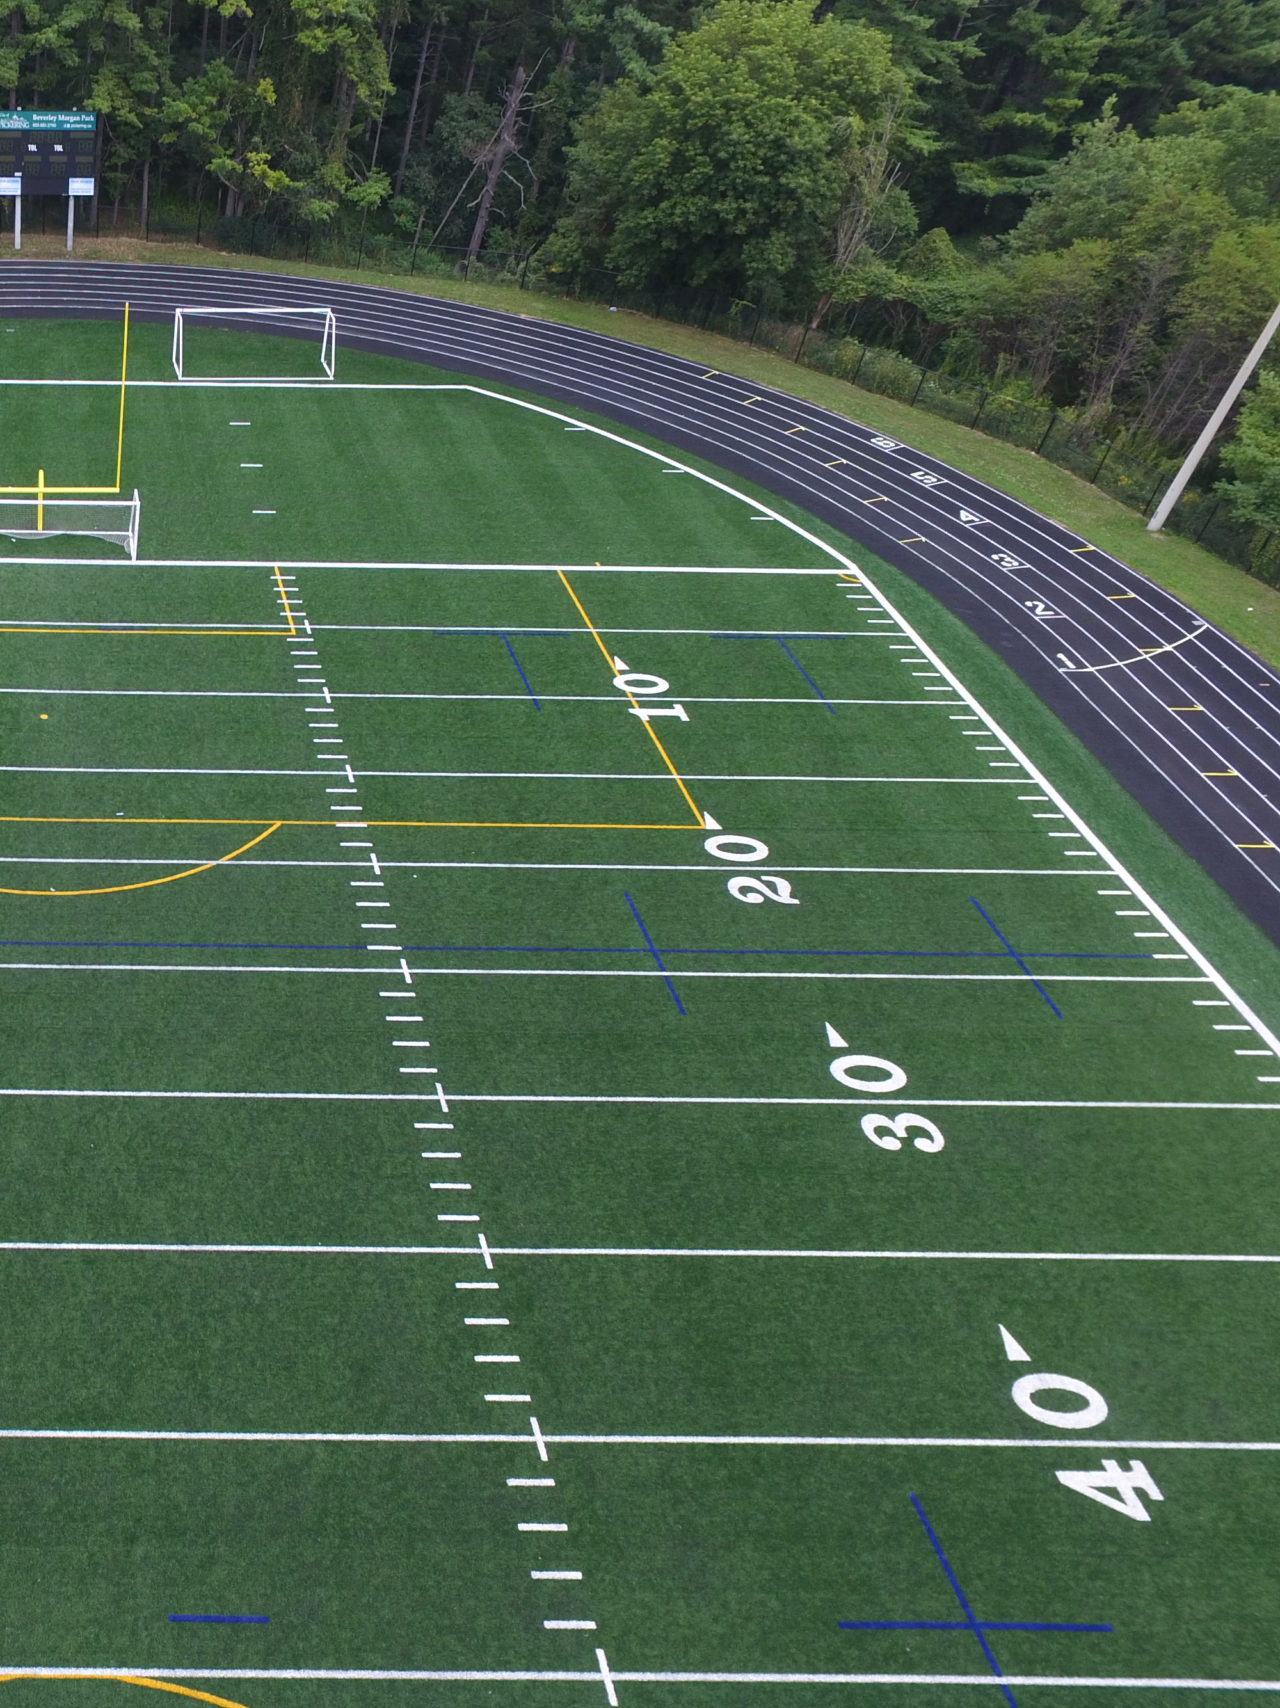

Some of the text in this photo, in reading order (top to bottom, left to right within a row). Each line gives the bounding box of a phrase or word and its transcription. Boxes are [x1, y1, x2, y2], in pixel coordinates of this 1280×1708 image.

[32, 114, 57, 122] Beverley
[871, 437, 895, 448] 6
[910, 471, 938, 484] 5
[960, 510, 980, 522] 4
[991, 553, 1019, 567] 3
[1025, 601, 1055, 615] 2
[1057, 653, 1076, 669] 1
[613, 673, 690, 721] 10
[704, 835, 800, 904] 20
[830, 1055, 945, 1153] 30
[1011, 1373, 1164, 1521] 40
